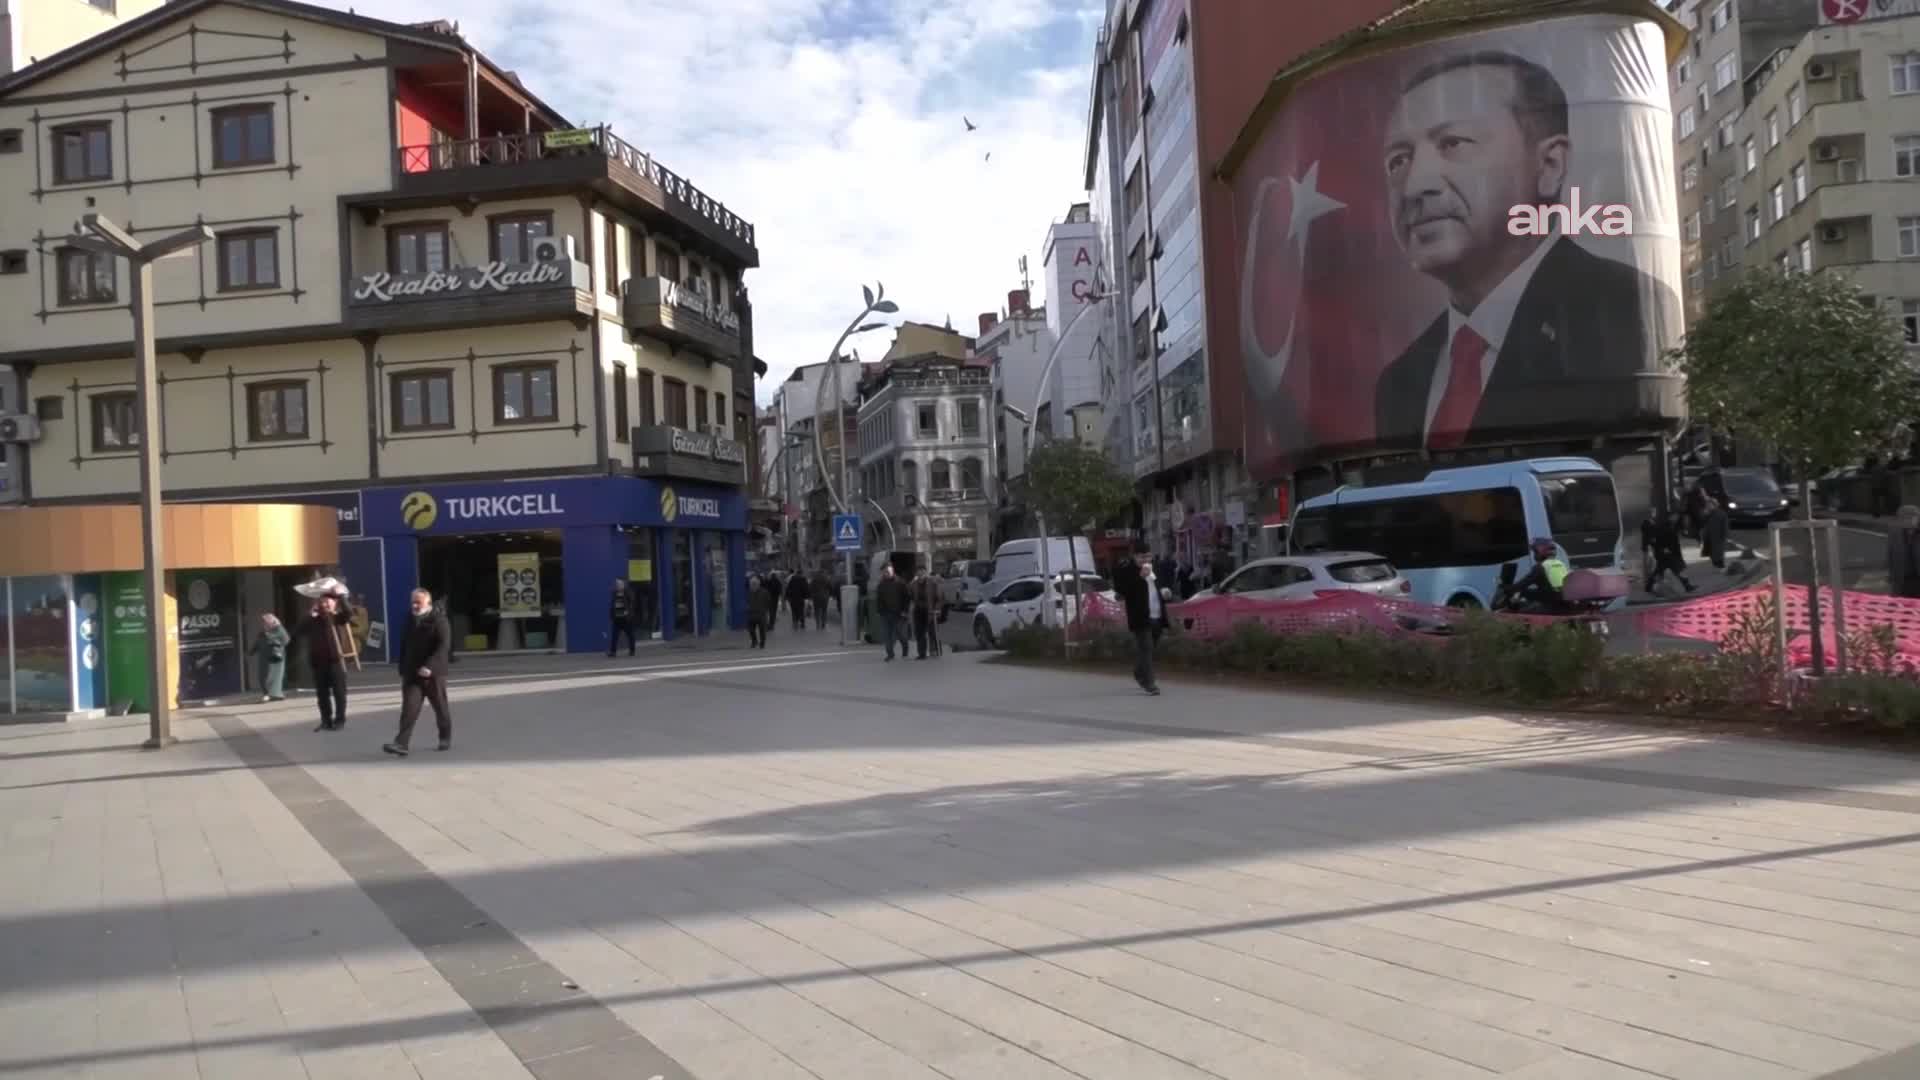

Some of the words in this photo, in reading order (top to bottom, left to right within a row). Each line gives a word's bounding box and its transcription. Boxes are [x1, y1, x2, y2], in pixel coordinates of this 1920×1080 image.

[354, 271, 462, 301] Kuaför
[469, 261, 563, 291] Kadir
[445, 493, 565, 519] TURKCELL
[678, 496, 721, 517] TURKCELL
